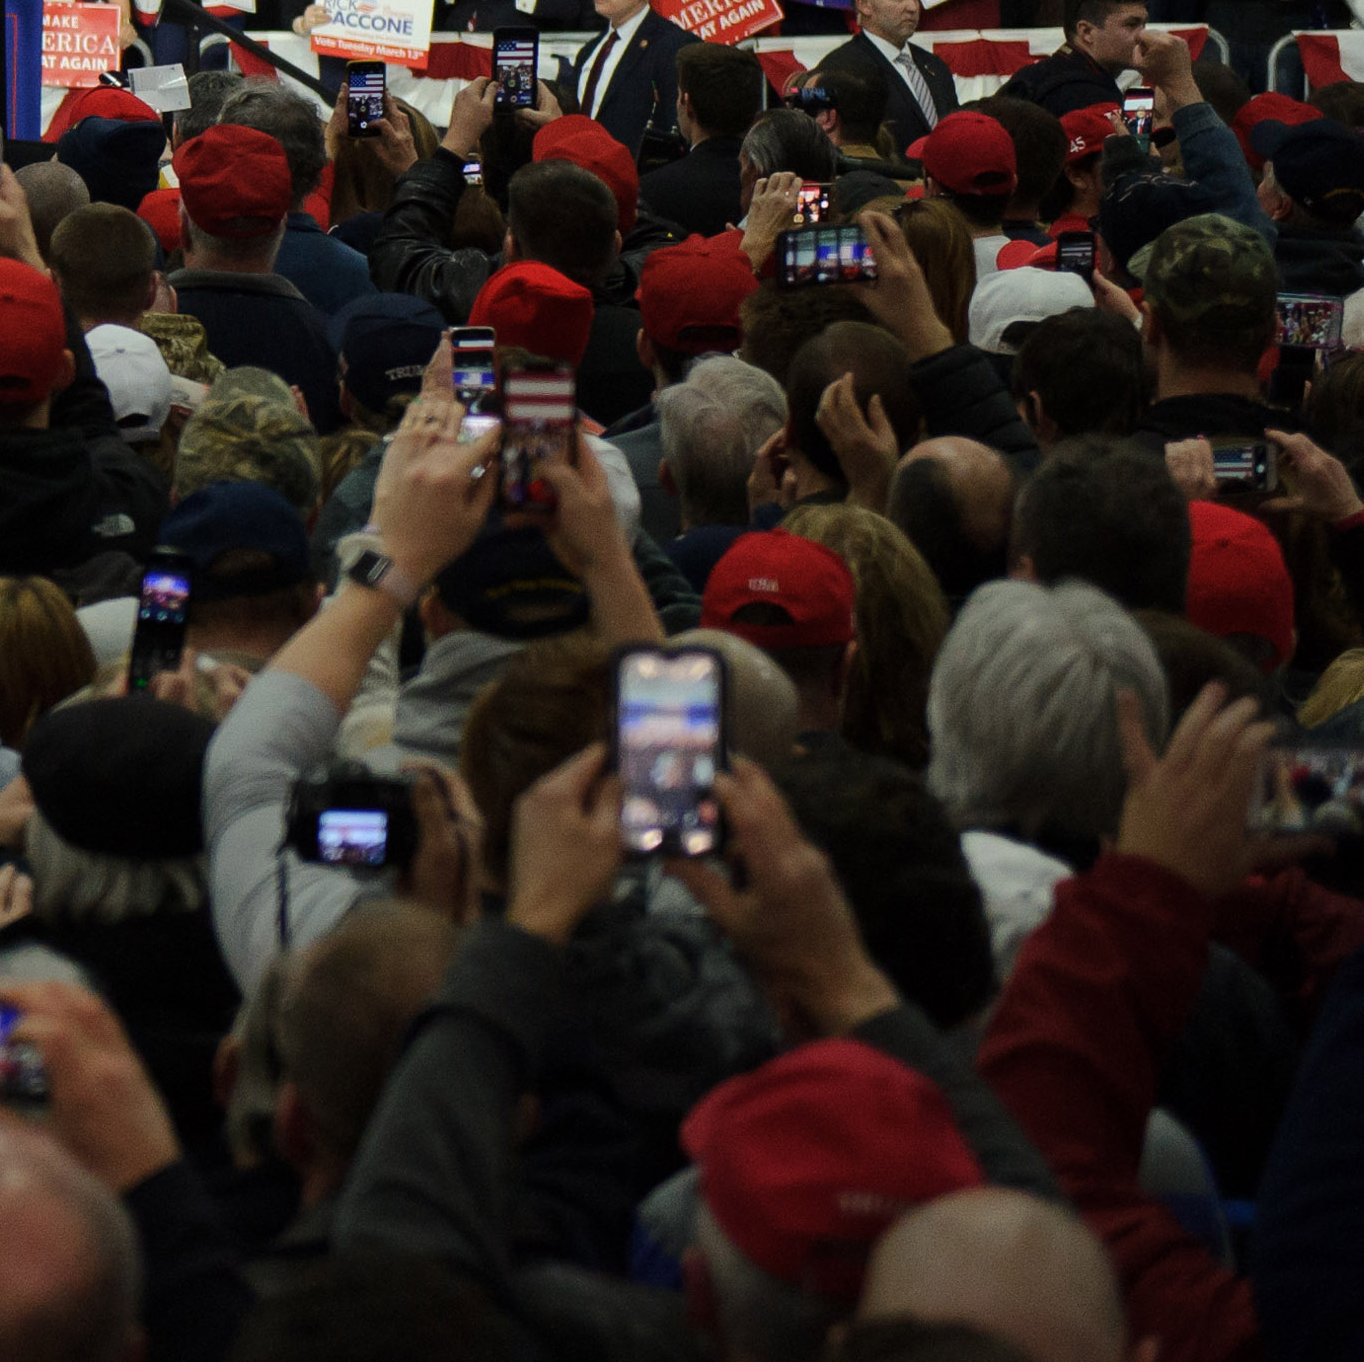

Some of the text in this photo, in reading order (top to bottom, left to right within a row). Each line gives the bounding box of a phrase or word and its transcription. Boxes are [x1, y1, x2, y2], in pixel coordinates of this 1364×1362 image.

[42, 31, 115, 54] ERICA
[314, 36, 336, 45] Vote
[337, 39, 375, 55] Tuesday
[376, 44, 406, 58] March
[60, 55, 108, 70] AGAIN
[385, 365, 423, 381] TRU
